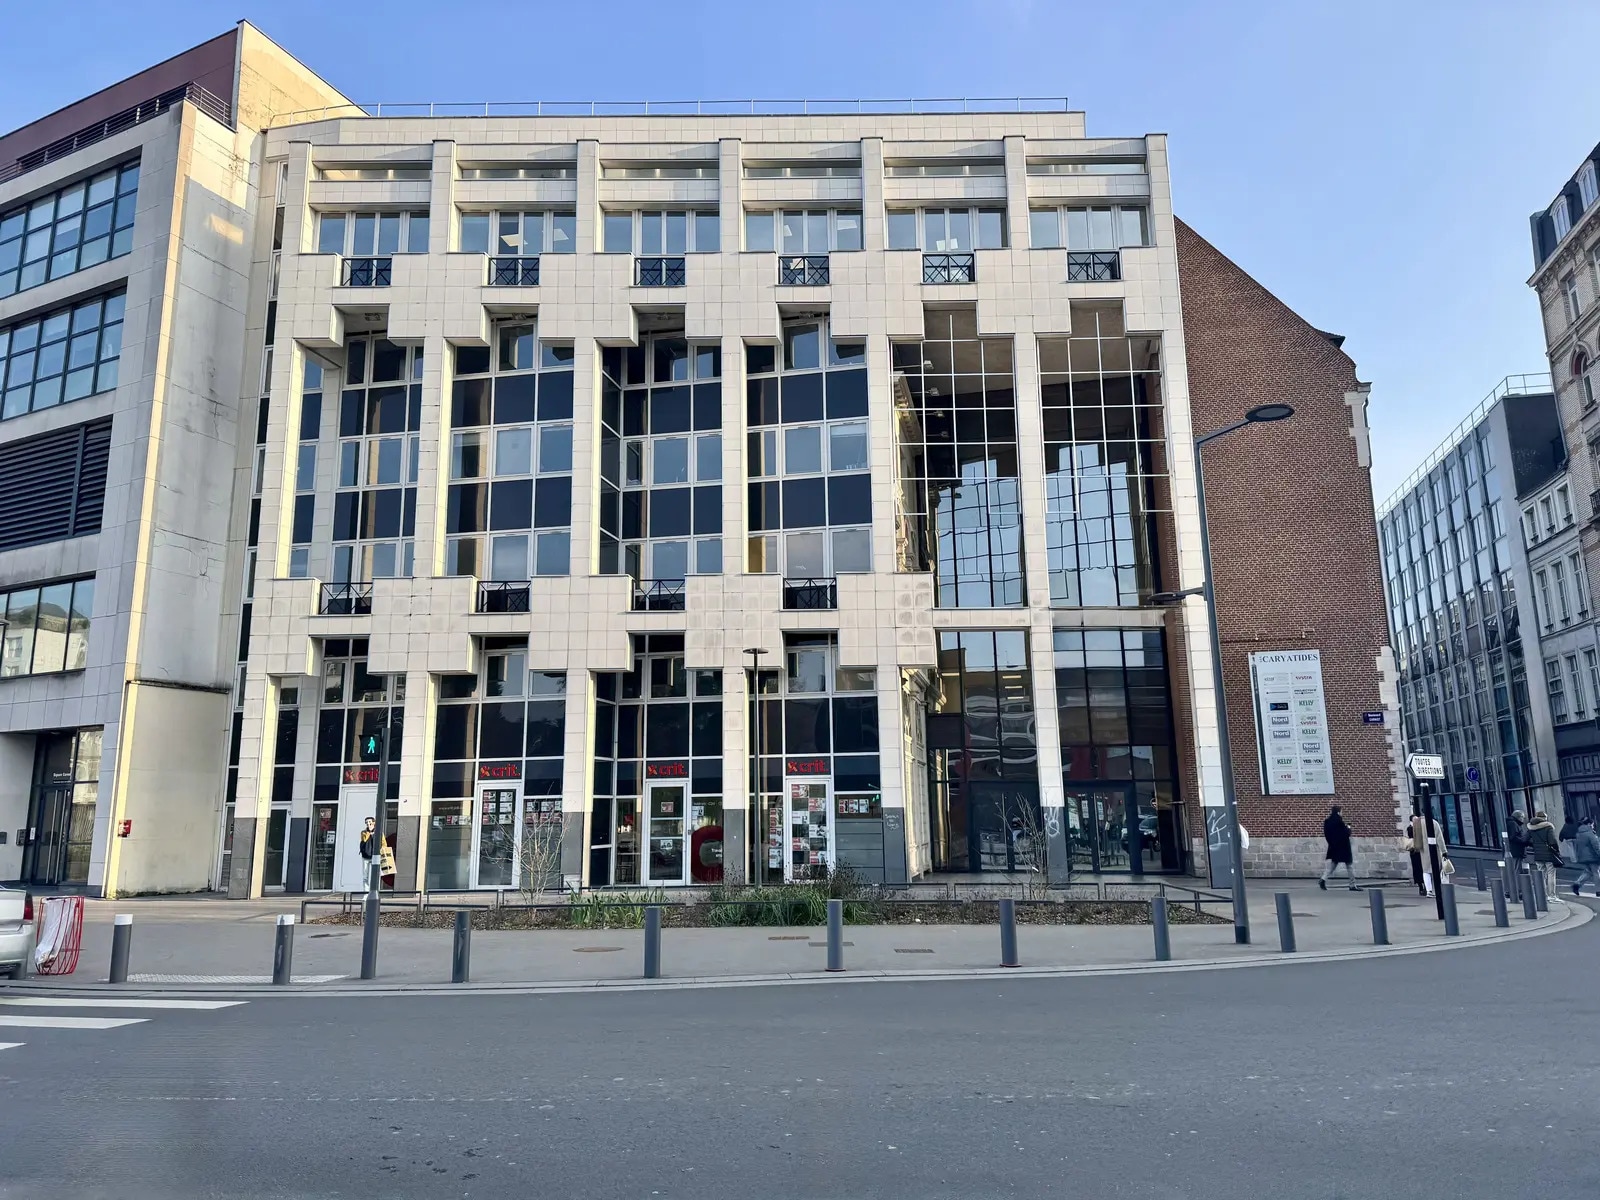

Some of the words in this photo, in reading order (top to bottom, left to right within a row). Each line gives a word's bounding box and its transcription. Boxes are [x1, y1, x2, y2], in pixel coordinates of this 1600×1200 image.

[1262, 654, 1318, 663] CARYATIDES
[1415, 758, 1431, 766] TOUTES
[1417, 767, 1442, 775] DIRECTIONS
